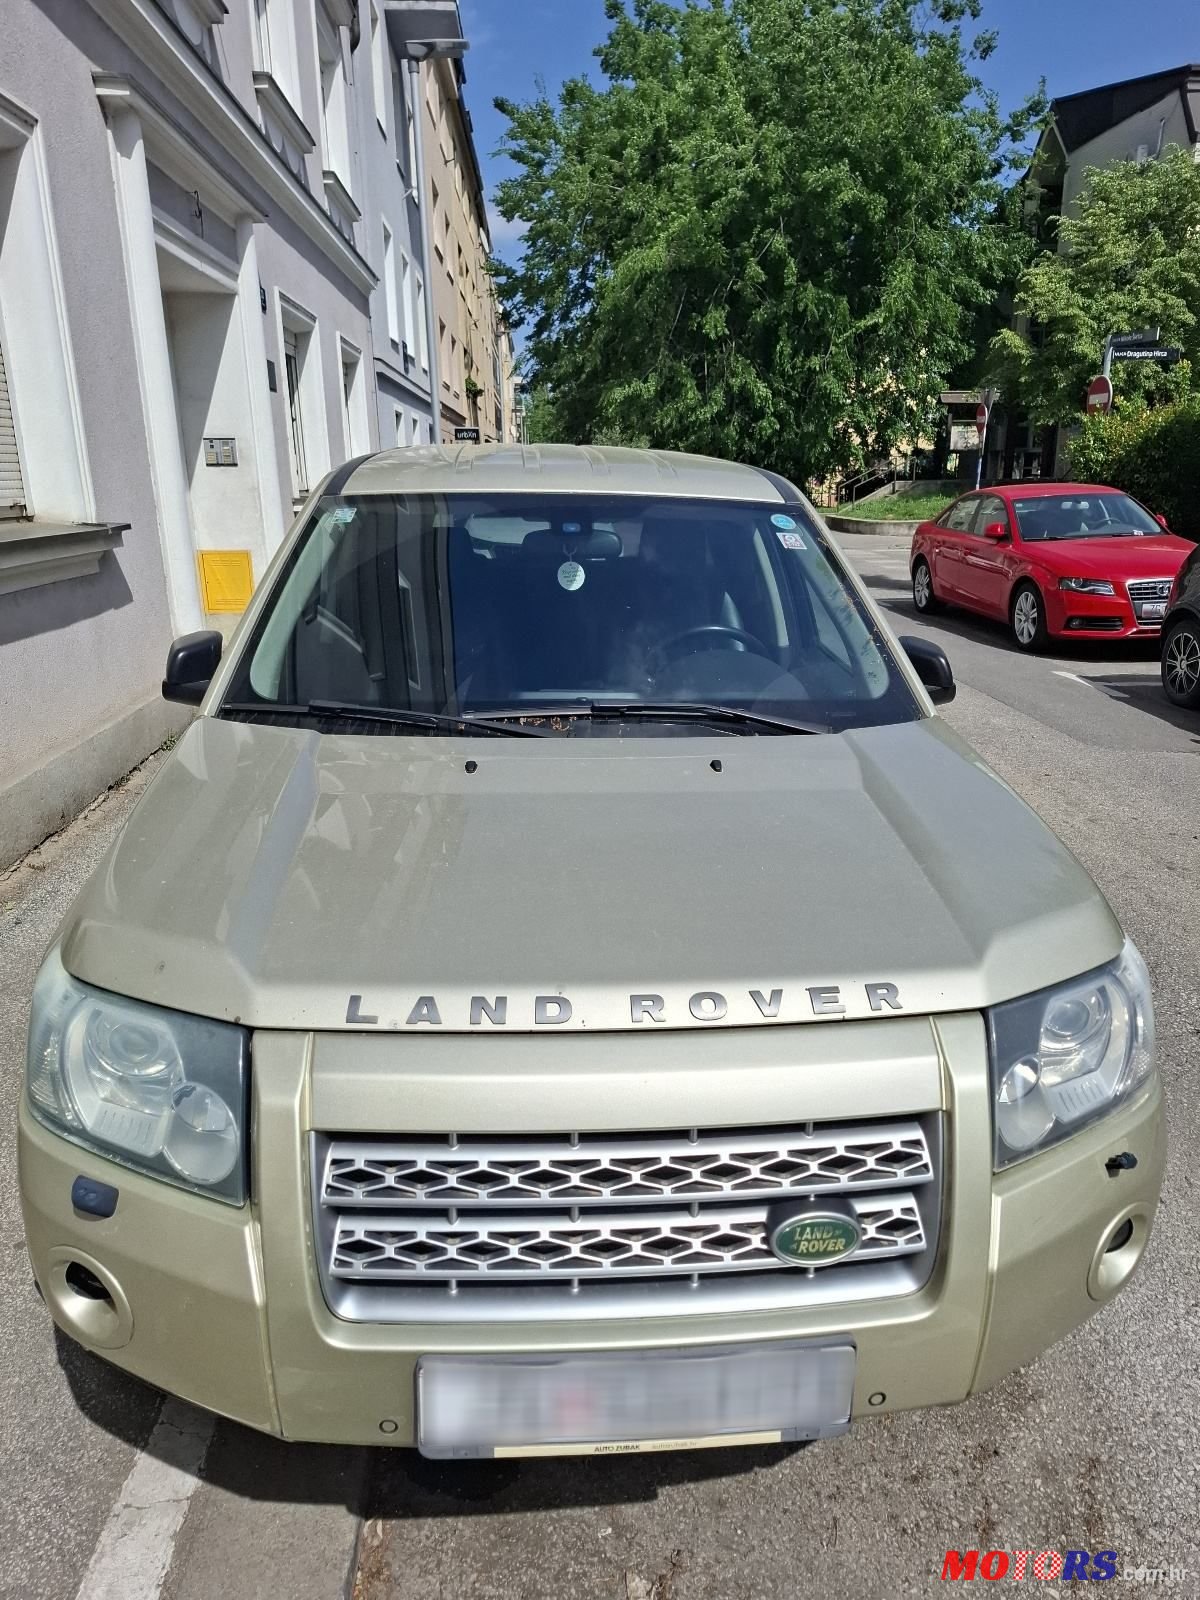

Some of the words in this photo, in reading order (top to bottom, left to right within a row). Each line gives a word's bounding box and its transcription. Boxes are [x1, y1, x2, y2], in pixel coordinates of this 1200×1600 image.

[346, 994, 573, 1025] LAND
[629, 981, 904, 1023] ROVER
[795, 1225, 833, 1241] LAND
[797, 1238, 846, 1254] ROVER
[594, 1445, 614, 1453] AUTO
[615, 1444, 640, 1452] ZUBAK
